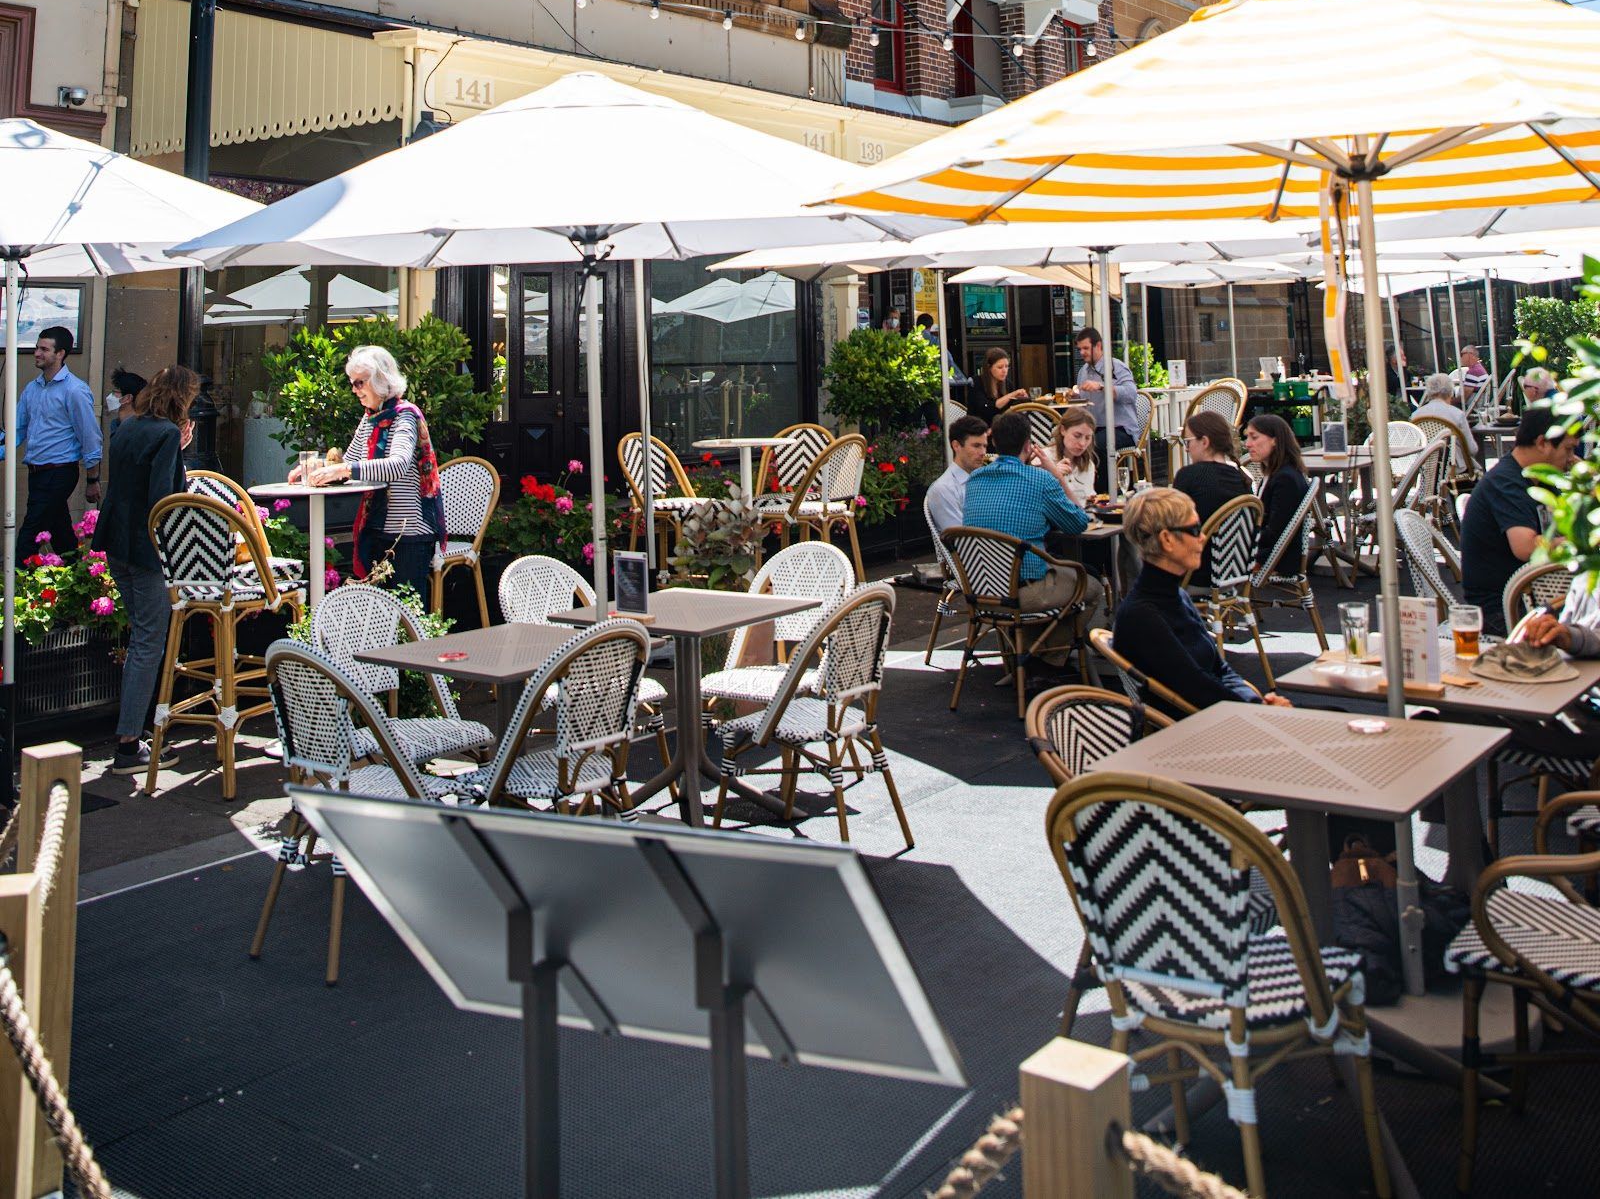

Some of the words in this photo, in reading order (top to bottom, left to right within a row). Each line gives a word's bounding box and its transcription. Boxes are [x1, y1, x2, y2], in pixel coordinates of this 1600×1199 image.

[456, 78, 492, 105] 141
[803, 130, 826, 153] 141
[861, 142, 883, 162] 139
